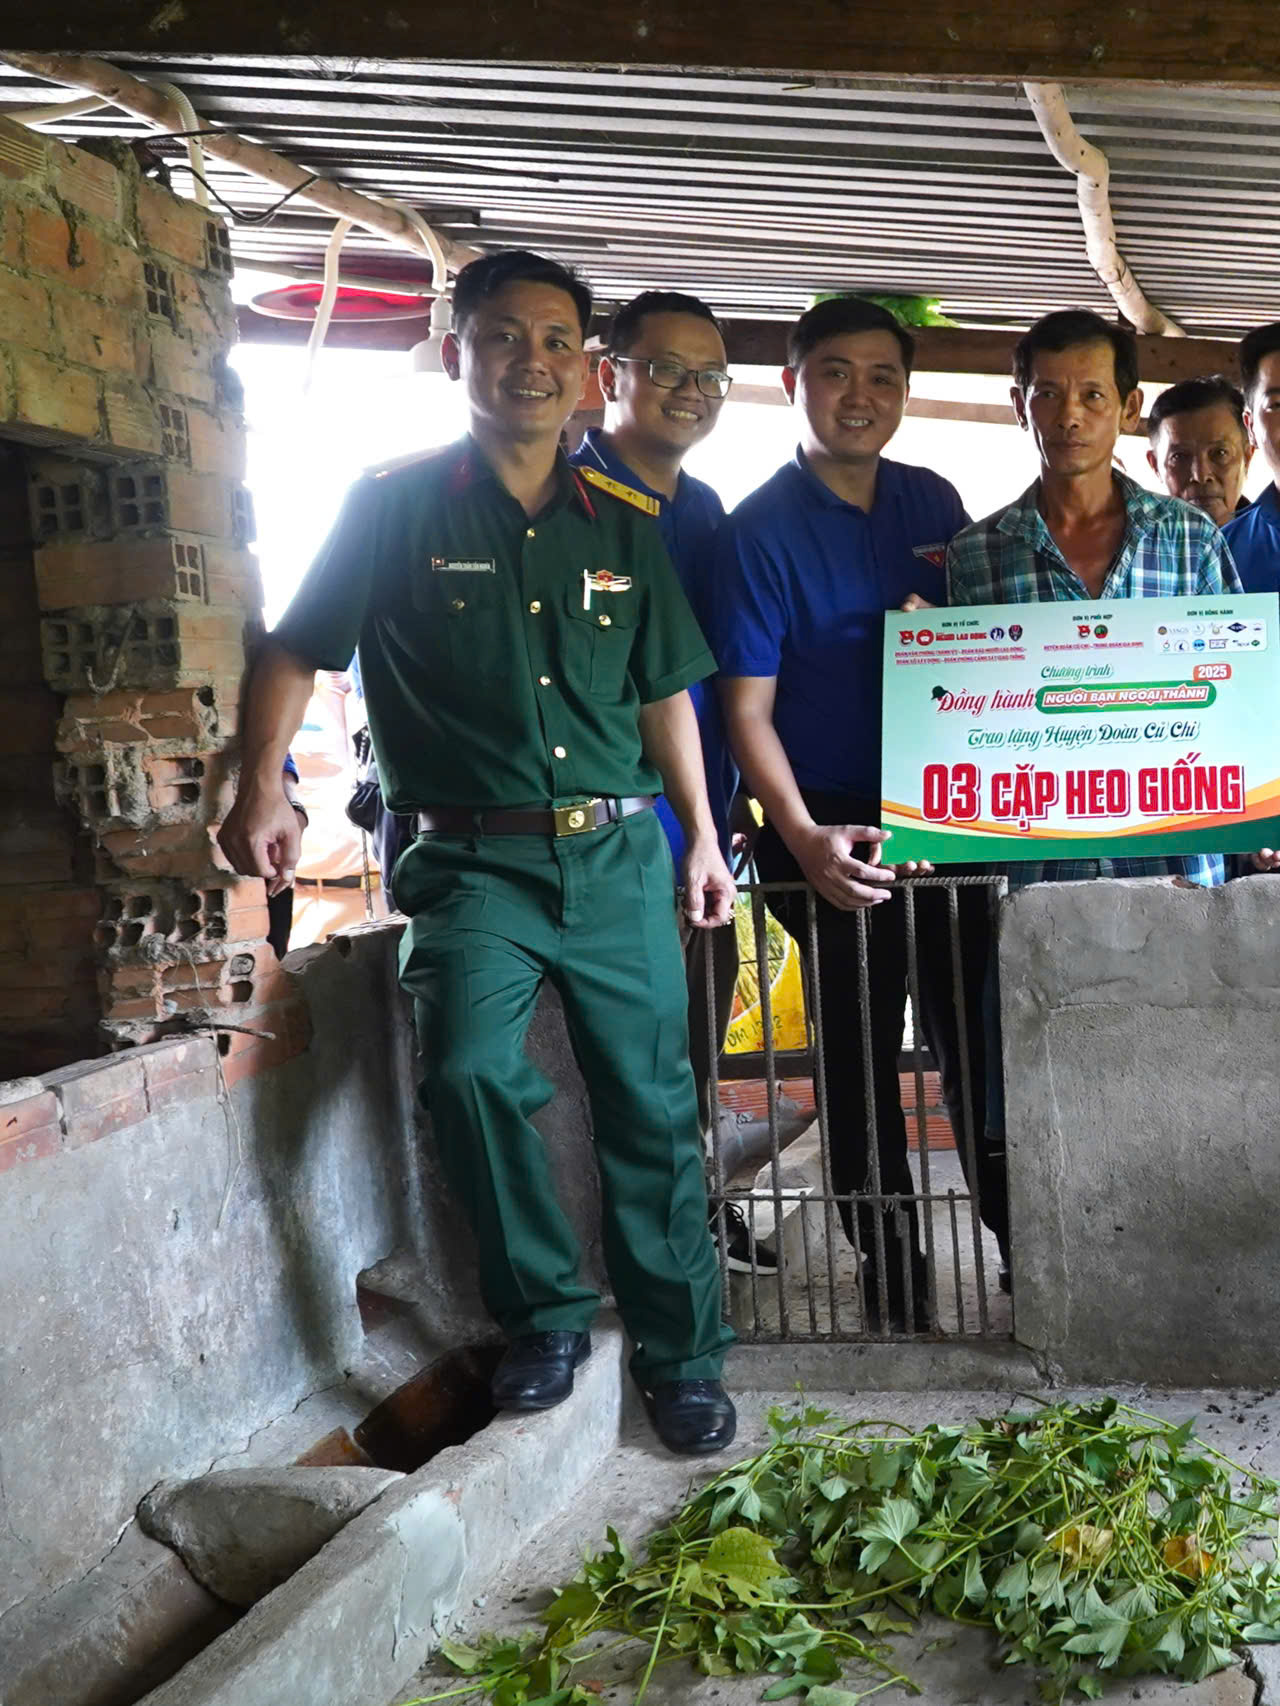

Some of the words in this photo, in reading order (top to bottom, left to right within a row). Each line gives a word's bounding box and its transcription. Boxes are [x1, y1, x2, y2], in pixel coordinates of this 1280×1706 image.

[1041, 664, 1082, 681] Chương
[1084, 663, 1112, 677] trình
[1198, 665, 1228, 679] 2025
[937, 687, 987, 715] Đồng
[990, 687, 1035, 709] hành
[1045, 688, 1089, 704] NGƯỜI
[1090, 691, 1116, 706] BẠN
[1119, 689, 1161, 705] NGOẠI
[1162, 685, 1206, 700] THÀNH
[967, 728, 1003, 746] Trao
[1007, 728, 1040, 747] tặng
[1045, 725, 1093, 746] Huyện
[1098, 723, 1138, 741] Đoàn
[1144, 721, 1165, 739] Củ
[1170, 720, 1197, 737] Chi
[923, 762, 979, 819] 03
[991, 763, 1056, 829] CẶP
[1066, 768, 1129, 815] HEO
[1138, 751, 1243, 812] GIỐNG
